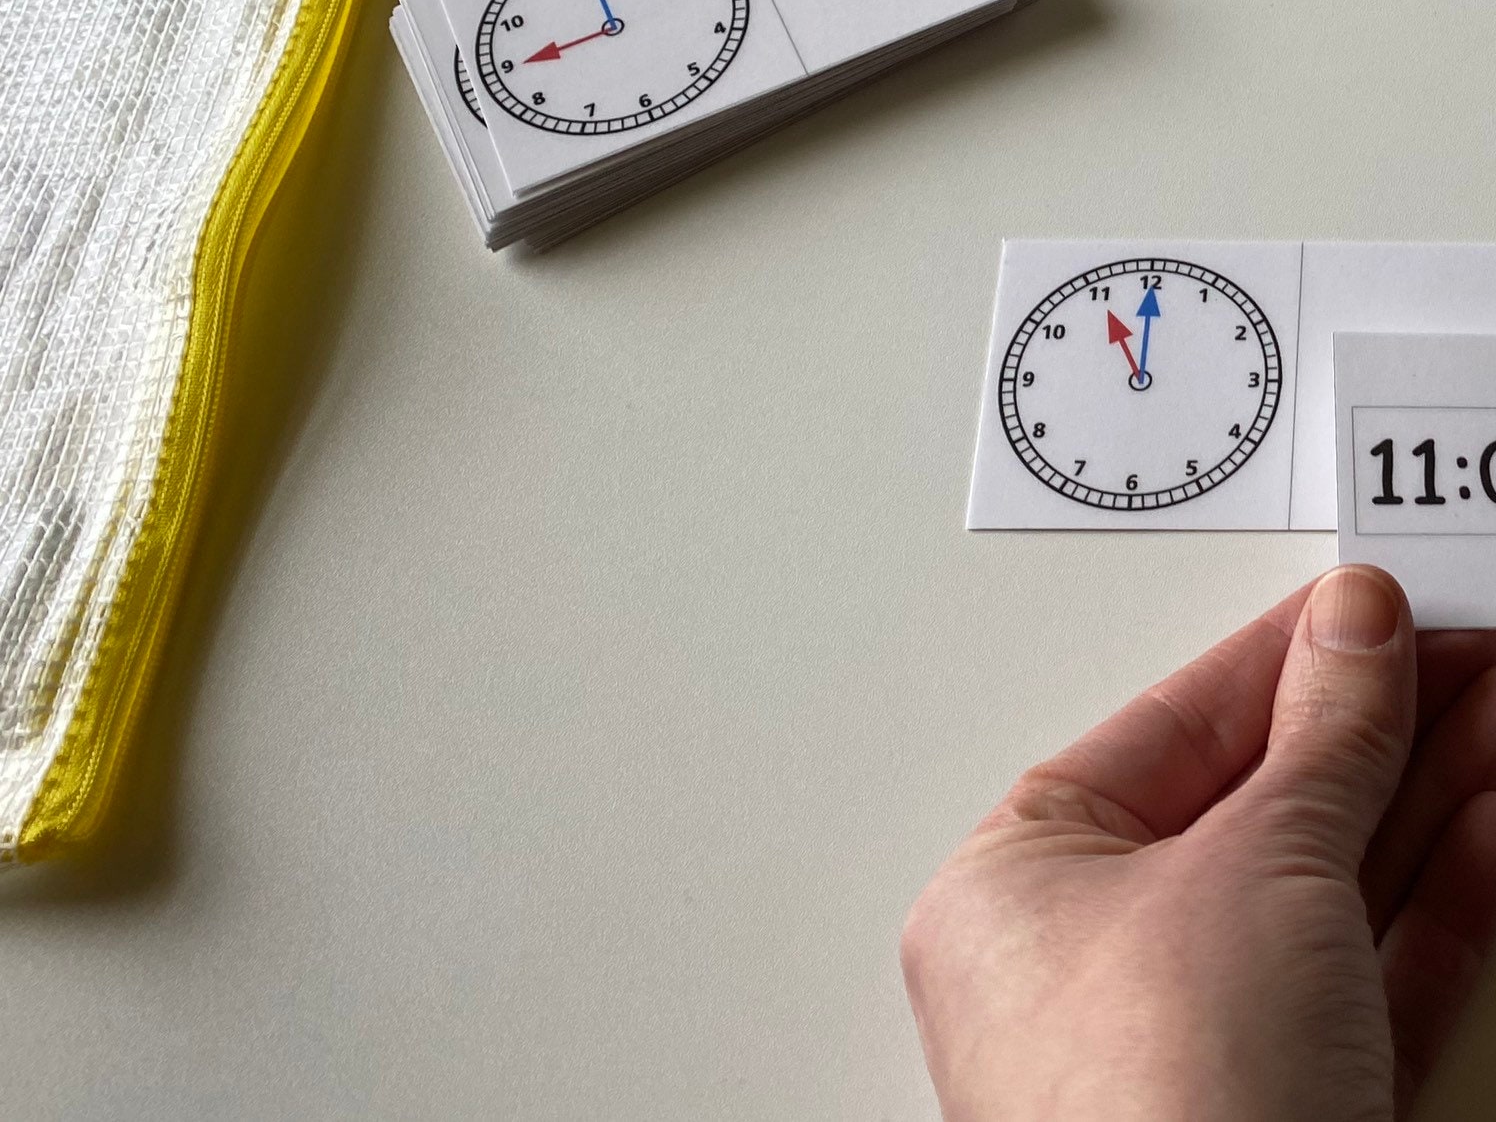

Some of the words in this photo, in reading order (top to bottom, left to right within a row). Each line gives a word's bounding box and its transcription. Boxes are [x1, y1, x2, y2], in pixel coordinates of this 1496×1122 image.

[500, 15, 524, 32] 10
[714, 22, 726, 33] 4
[501, 60, 514, 73] 9
[687, 62, 700, 76] 5
[532, 92, 545, 105] 8
[639, 94, 652, 107] 6
[584, 103, 595, 117] 7
[1140, 275, 1162, 290] 12
[1089, 287, 1110, 301] 11
[1199, 288, 1207, 303] 1
[1042, 325, 1065, 339] 10
[1235, 326, 1246, 340] 2
[1023, 372, 1034, 387] 9
[1248, 372, 1259, 388] 3
[1033, 422, 1046, 438] 8
[1229, 424, 1241, 439] 4
[1075, 460, 1086, 476] 7
[1186, 460, 1198, 476] 5
[1126, 474, 1138, 491] 6
